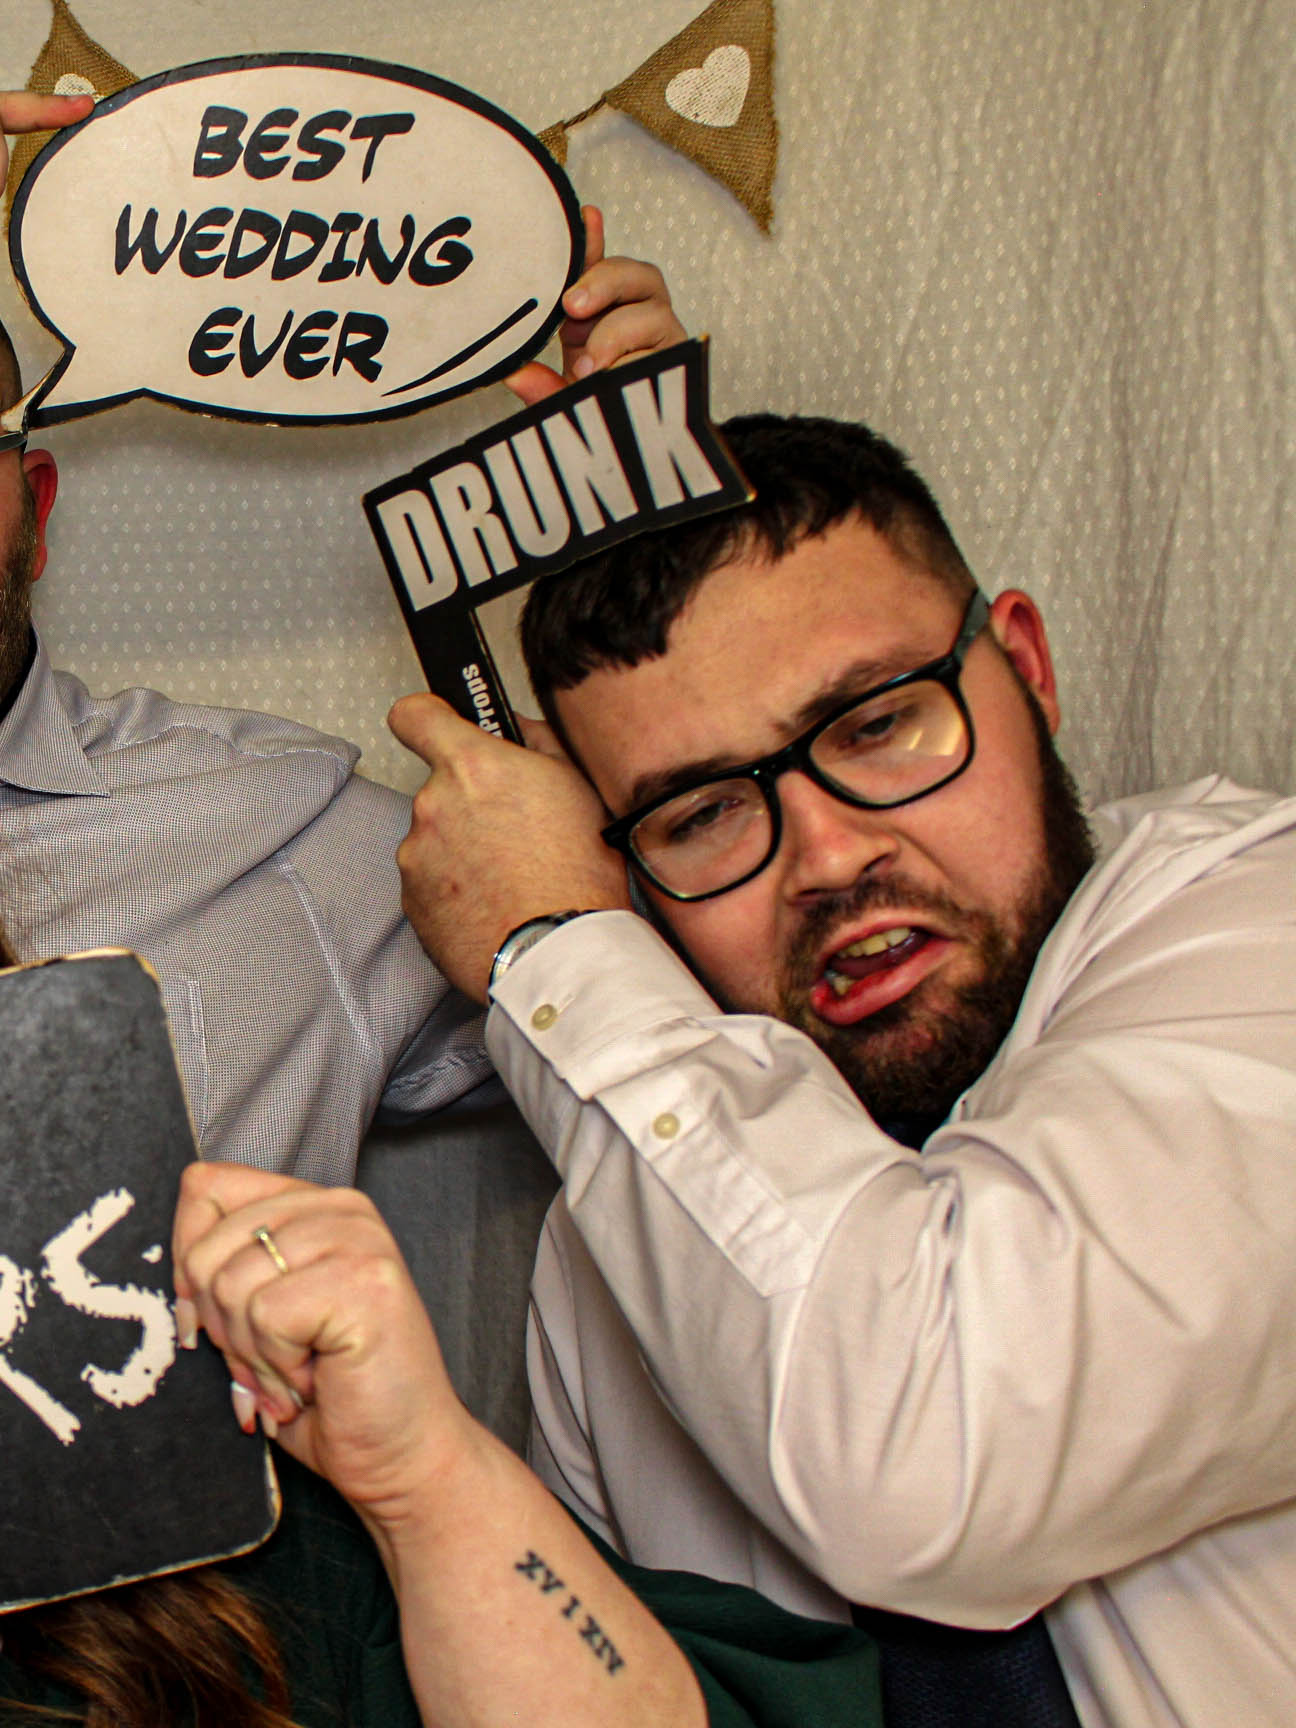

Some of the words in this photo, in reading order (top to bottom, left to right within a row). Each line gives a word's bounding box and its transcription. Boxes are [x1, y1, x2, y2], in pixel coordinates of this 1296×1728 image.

[192, 105, 416, 184] BEST
[114, 204, 474, 287] WEDDING
[188, 306, 390, 384] EVER
[376, 364, 724, 613] DRUNK
[514, 1550, 565, 1594] XV
[561, 1595, 581, 1619] I
